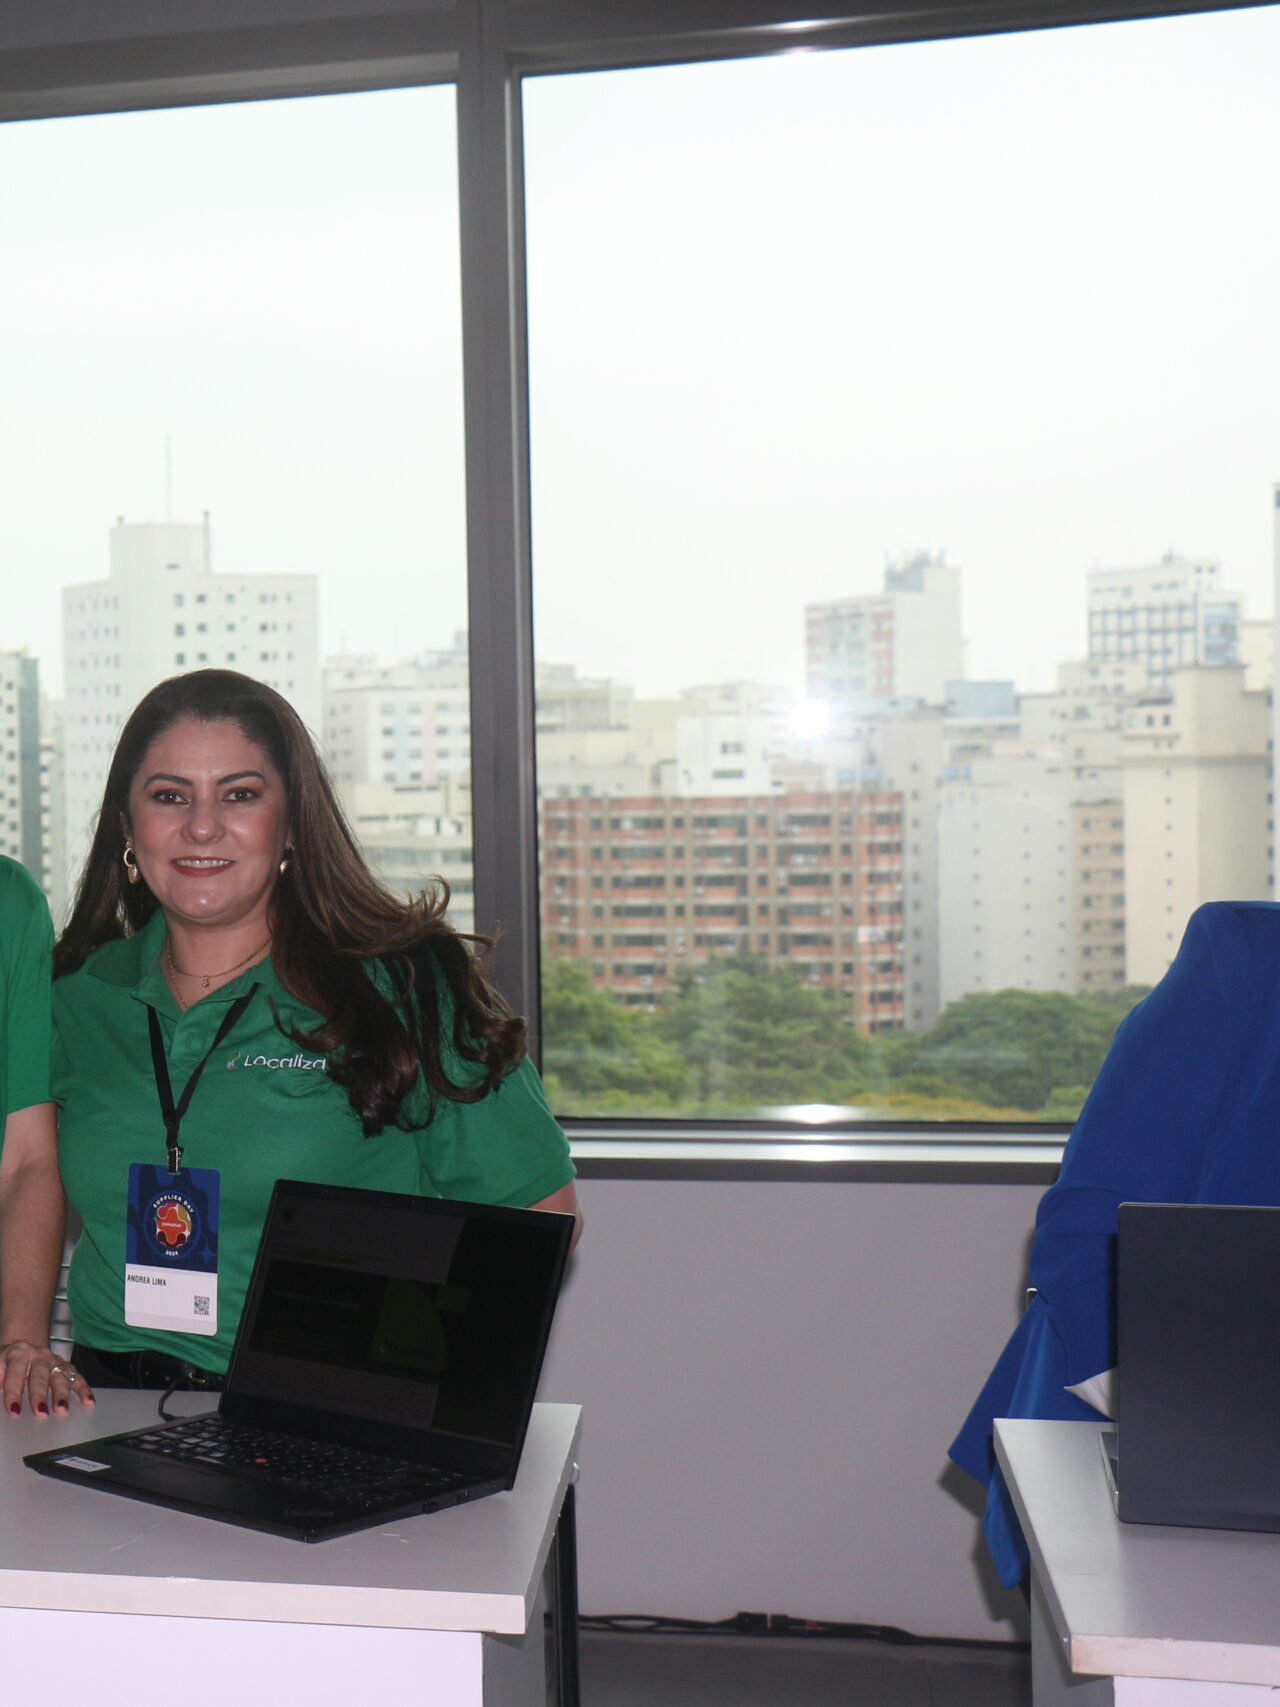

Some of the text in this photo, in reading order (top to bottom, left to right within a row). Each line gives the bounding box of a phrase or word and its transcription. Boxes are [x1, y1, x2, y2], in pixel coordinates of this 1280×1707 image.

[152, 1194, 195, 1213] SUPPLIER DAY
[127, 1274, 167, 1287] ANDREA LIMA
